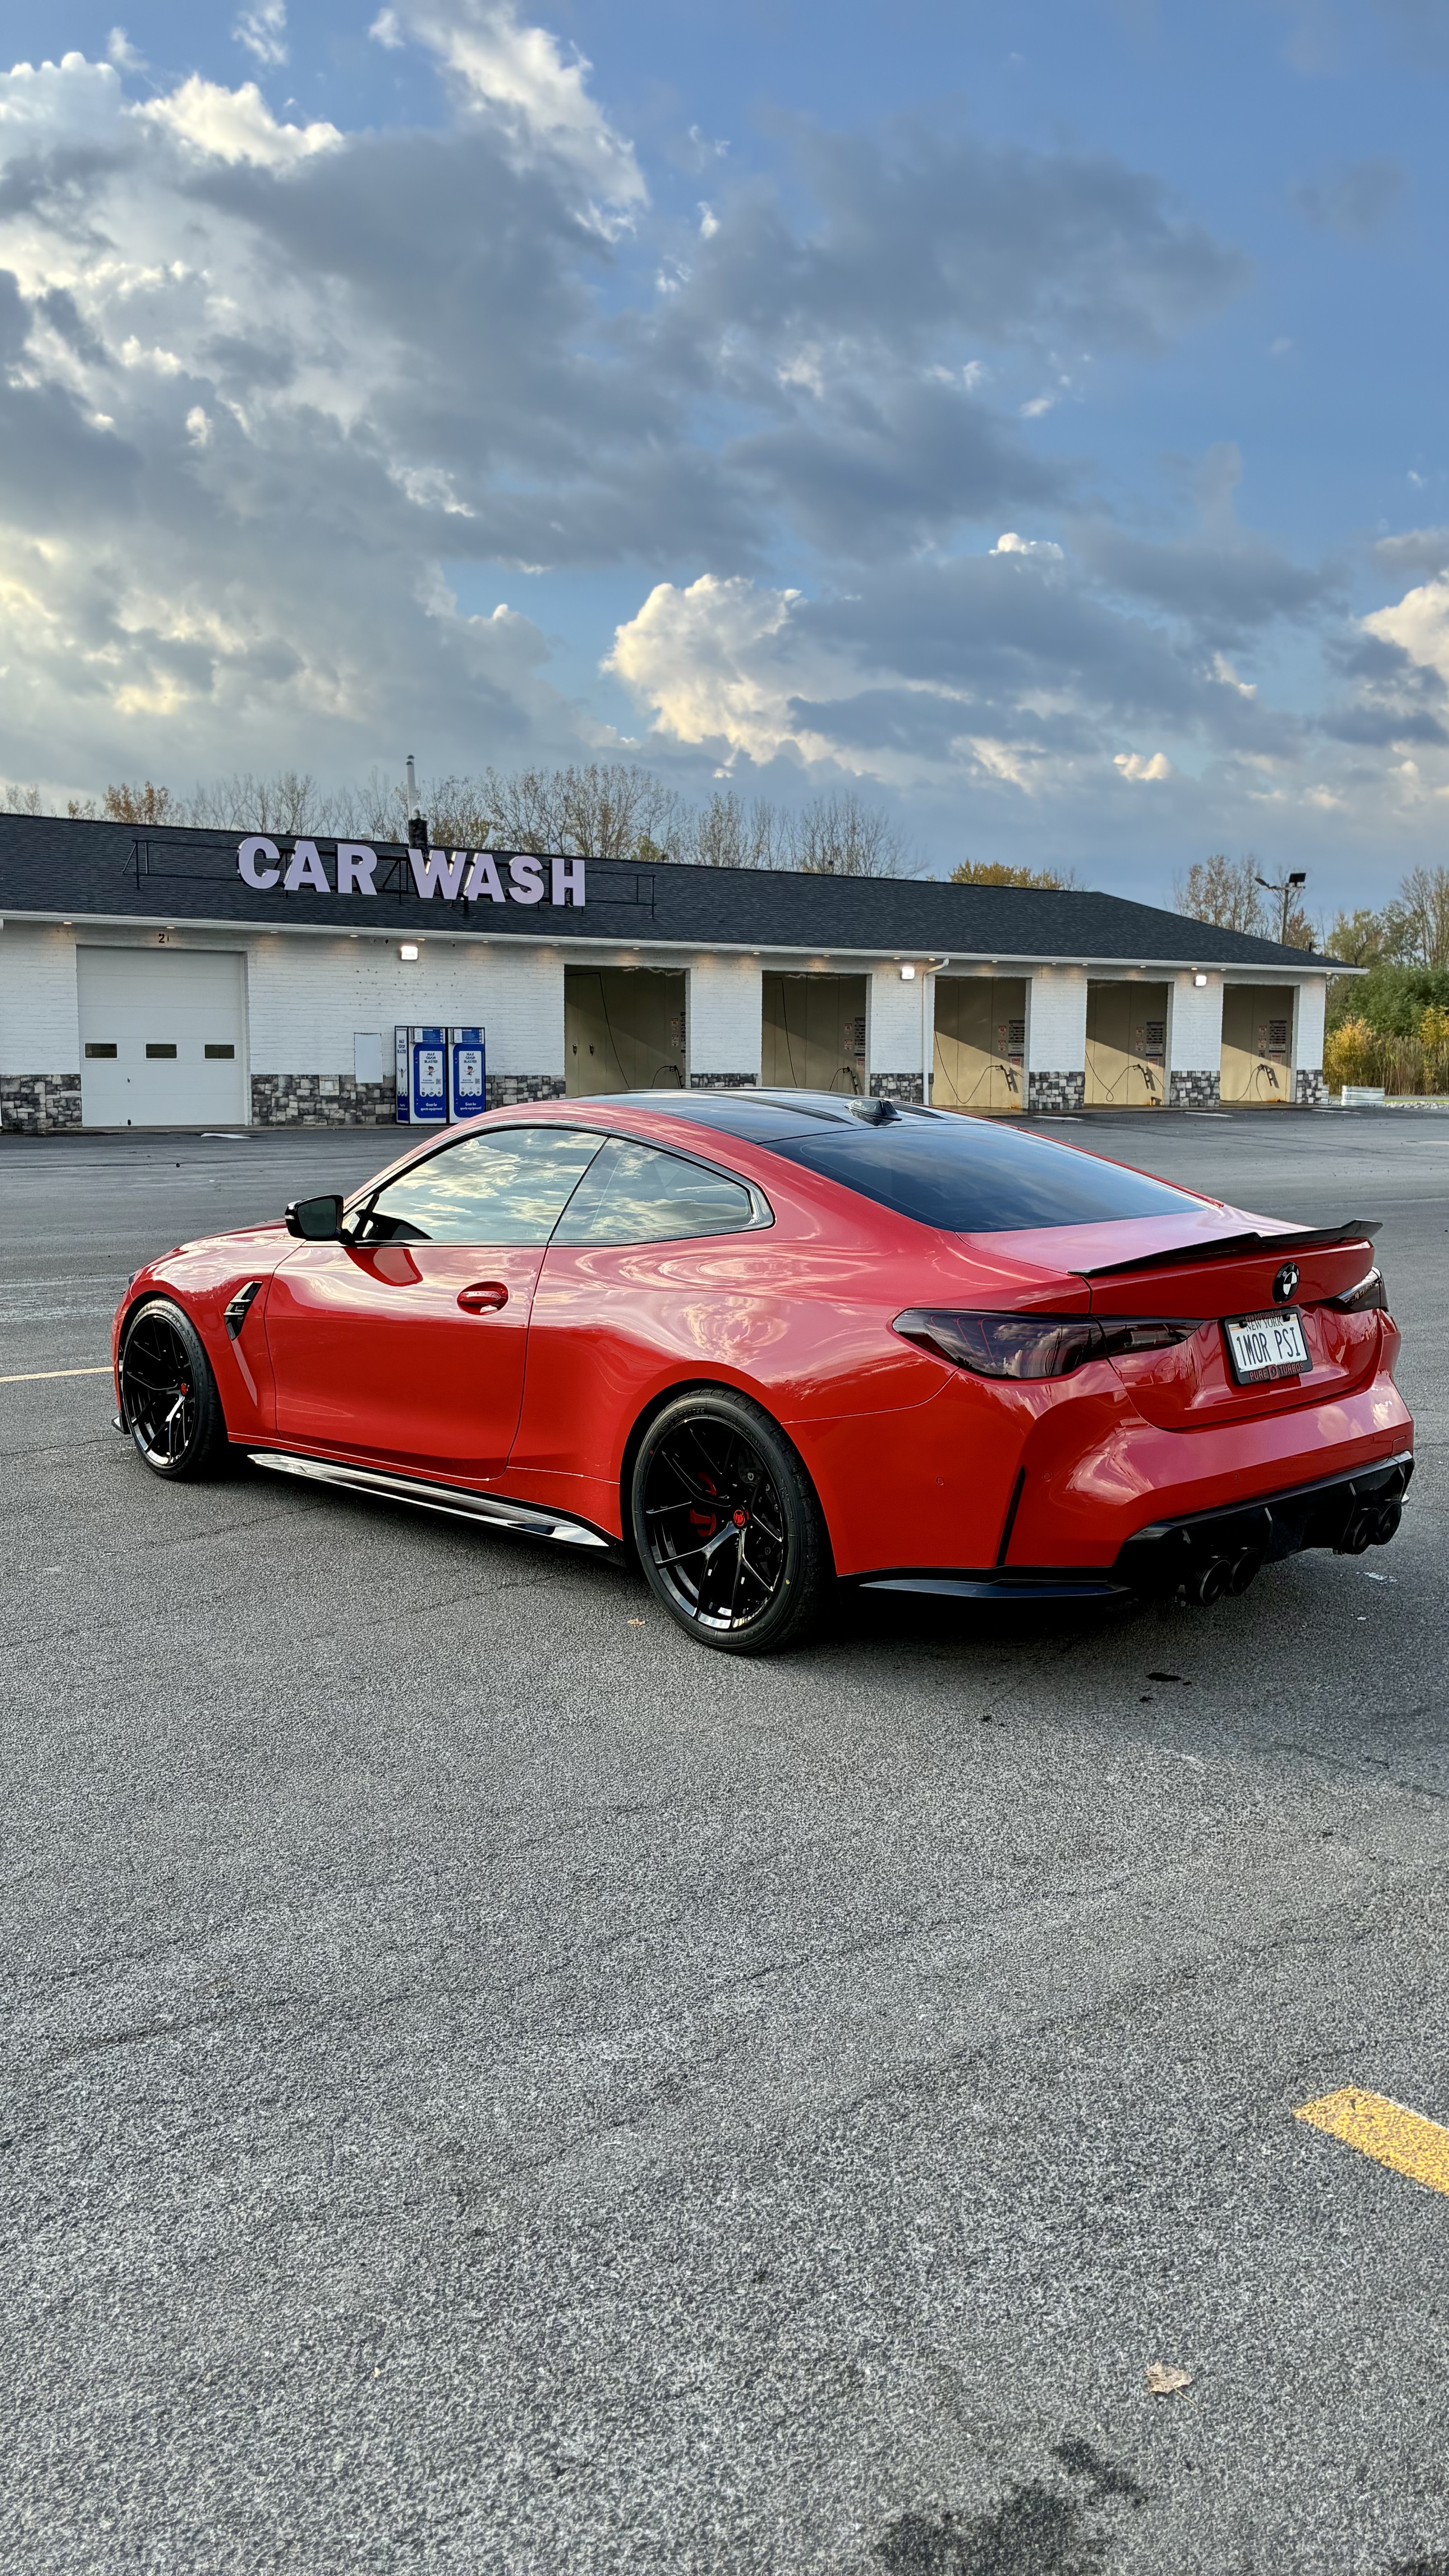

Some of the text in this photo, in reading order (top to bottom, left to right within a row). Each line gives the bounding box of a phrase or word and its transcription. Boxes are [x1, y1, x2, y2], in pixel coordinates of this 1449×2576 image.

[237, 836, 586, 907] CAR WASH
[158, 933, 165, 943] 2
[1246, 1316, 1283, 1332] NEW YORK
[1236, 1327, 1301, 1366] 1MOR PSI
[1249, 1362, 1304, 1381] PURE TURBOS
